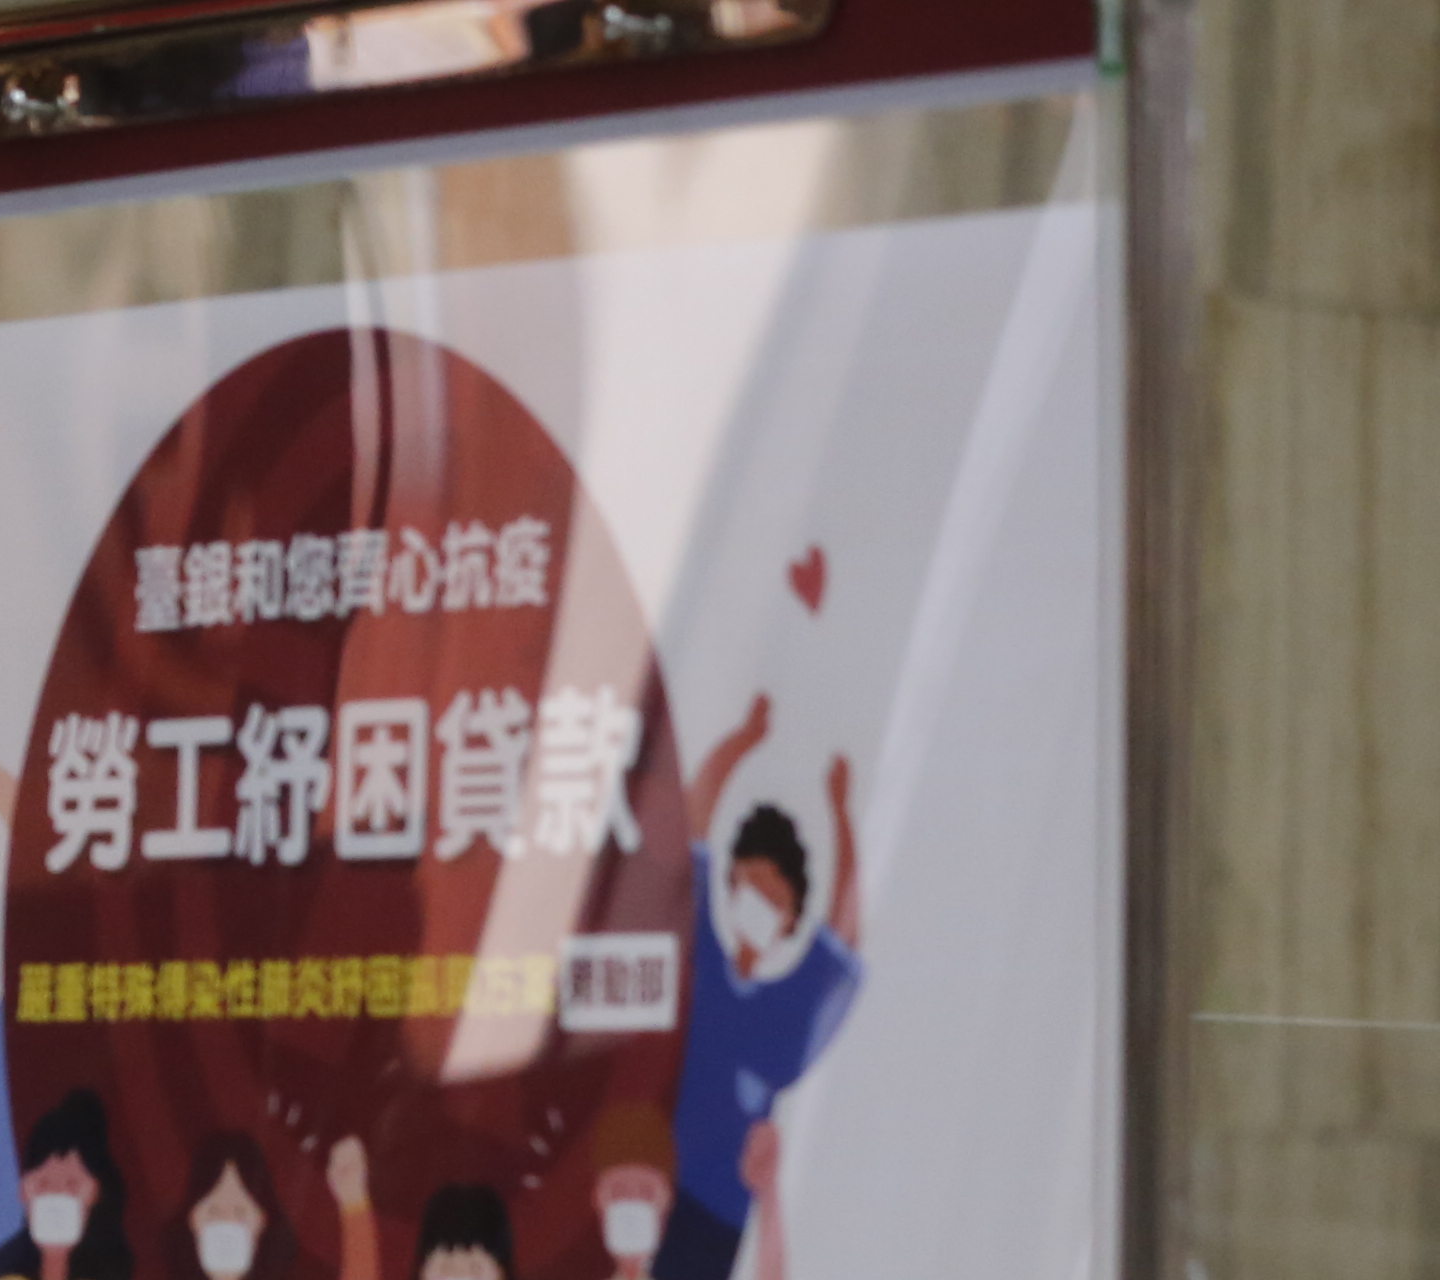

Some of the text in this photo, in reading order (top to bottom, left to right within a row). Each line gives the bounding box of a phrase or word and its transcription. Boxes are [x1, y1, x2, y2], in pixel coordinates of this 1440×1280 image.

[45, 684, 642, 875] 勞工紓困貸款
